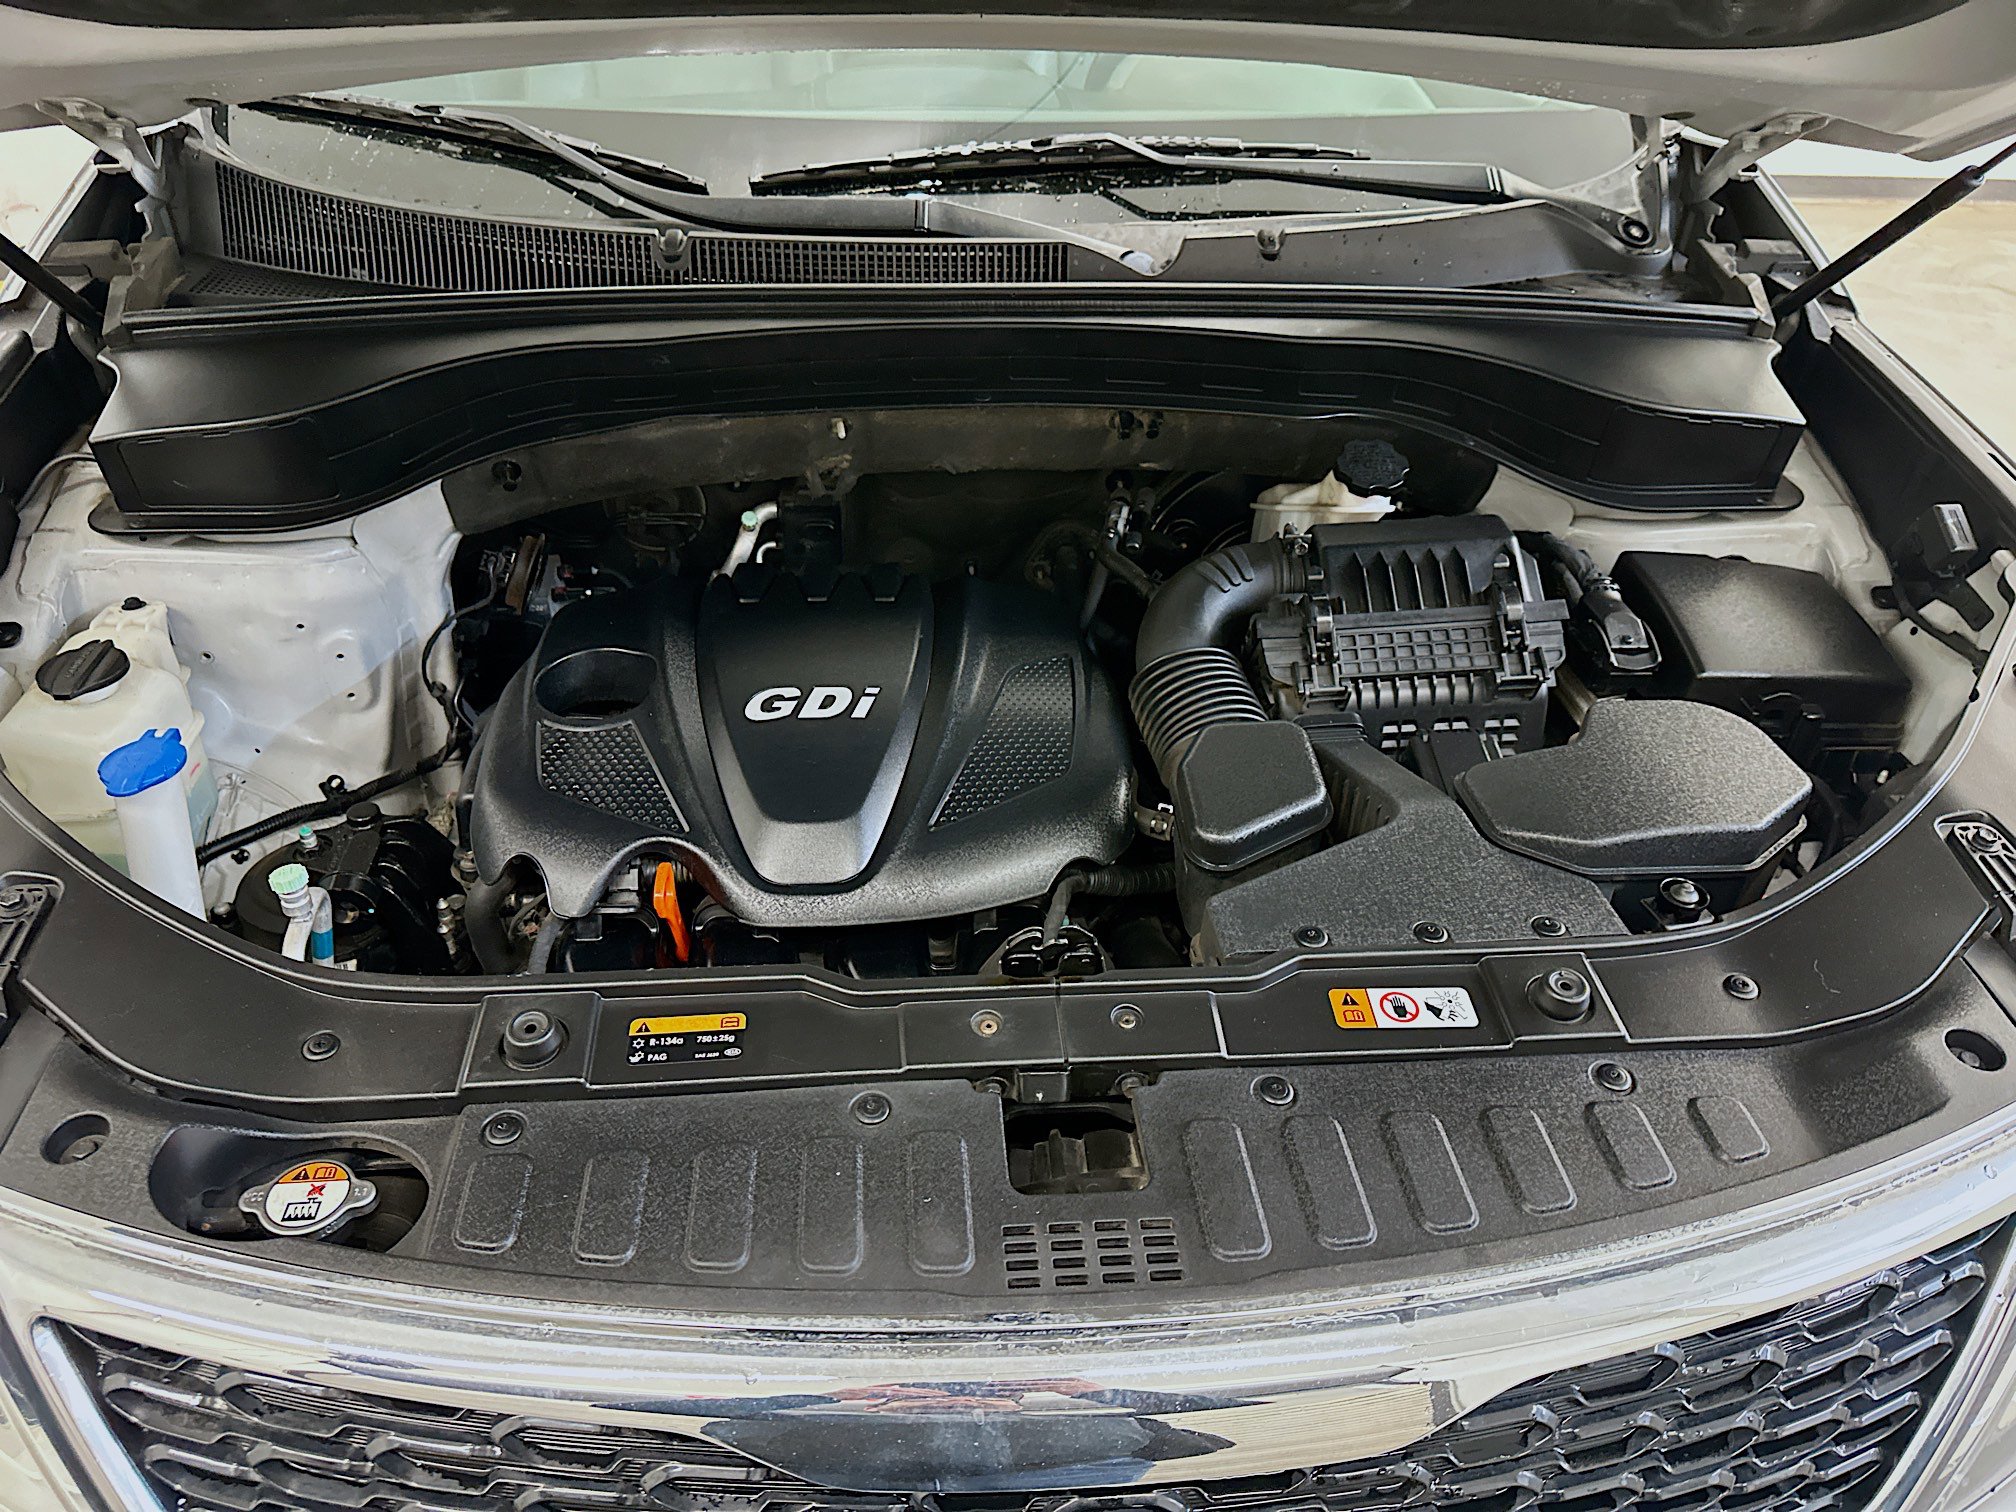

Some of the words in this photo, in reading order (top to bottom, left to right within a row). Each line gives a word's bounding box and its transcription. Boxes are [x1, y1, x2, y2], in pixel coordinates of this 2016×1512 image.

[744, 686, 881, 721] GDi
[649, 1037, 684, 1046] R-134a
[696, 1034, 736, 1043] 750±25g
[647, 1053, 668, 1062] PAG
